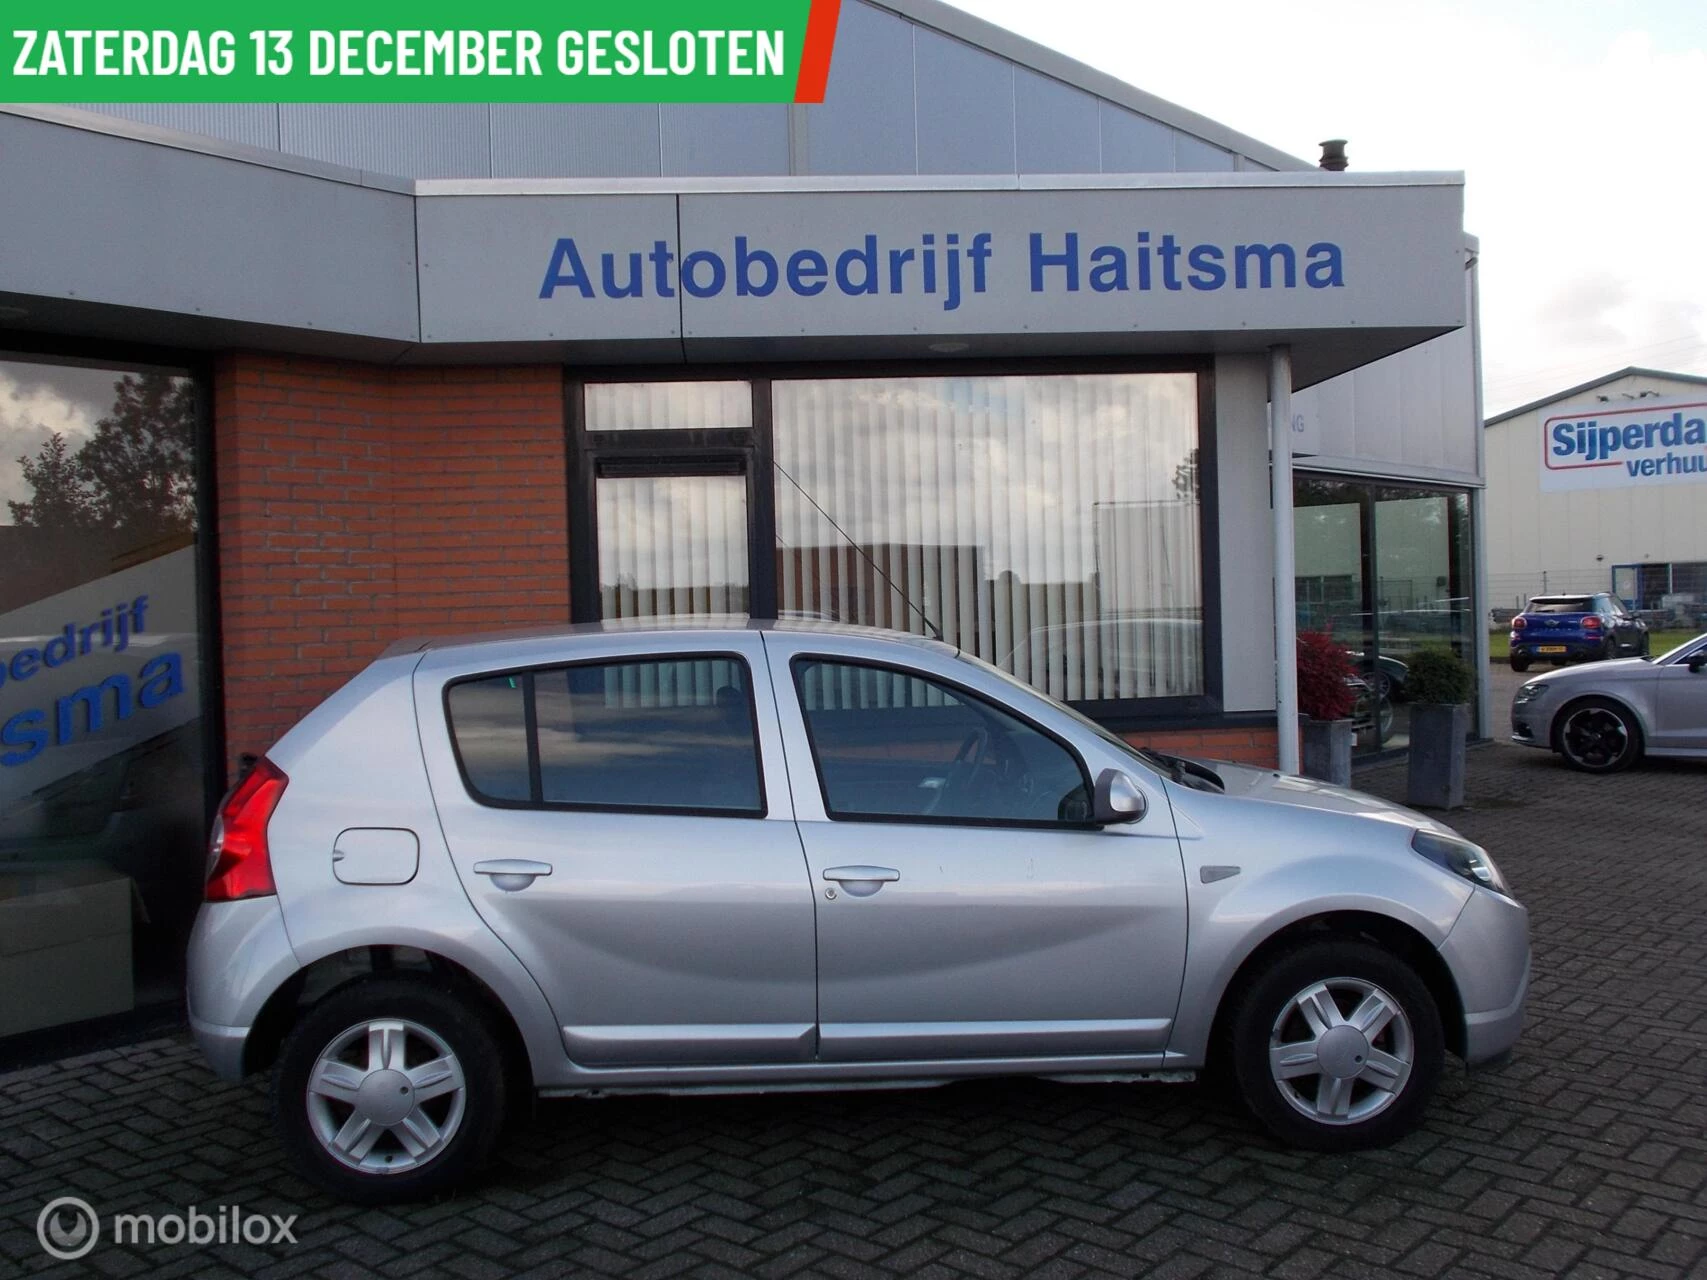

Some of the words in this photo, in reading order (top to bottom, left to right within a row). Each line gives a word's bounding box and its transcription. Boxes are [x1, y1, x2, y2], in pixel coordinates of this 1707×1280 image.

[540, 233, 992, 311] Autobedrijf
[1030, 230, 1344, 293] Haitsma
[1552, 412, 1706, 461] Sijperda
[0, 594, 149, 689] edrijf
